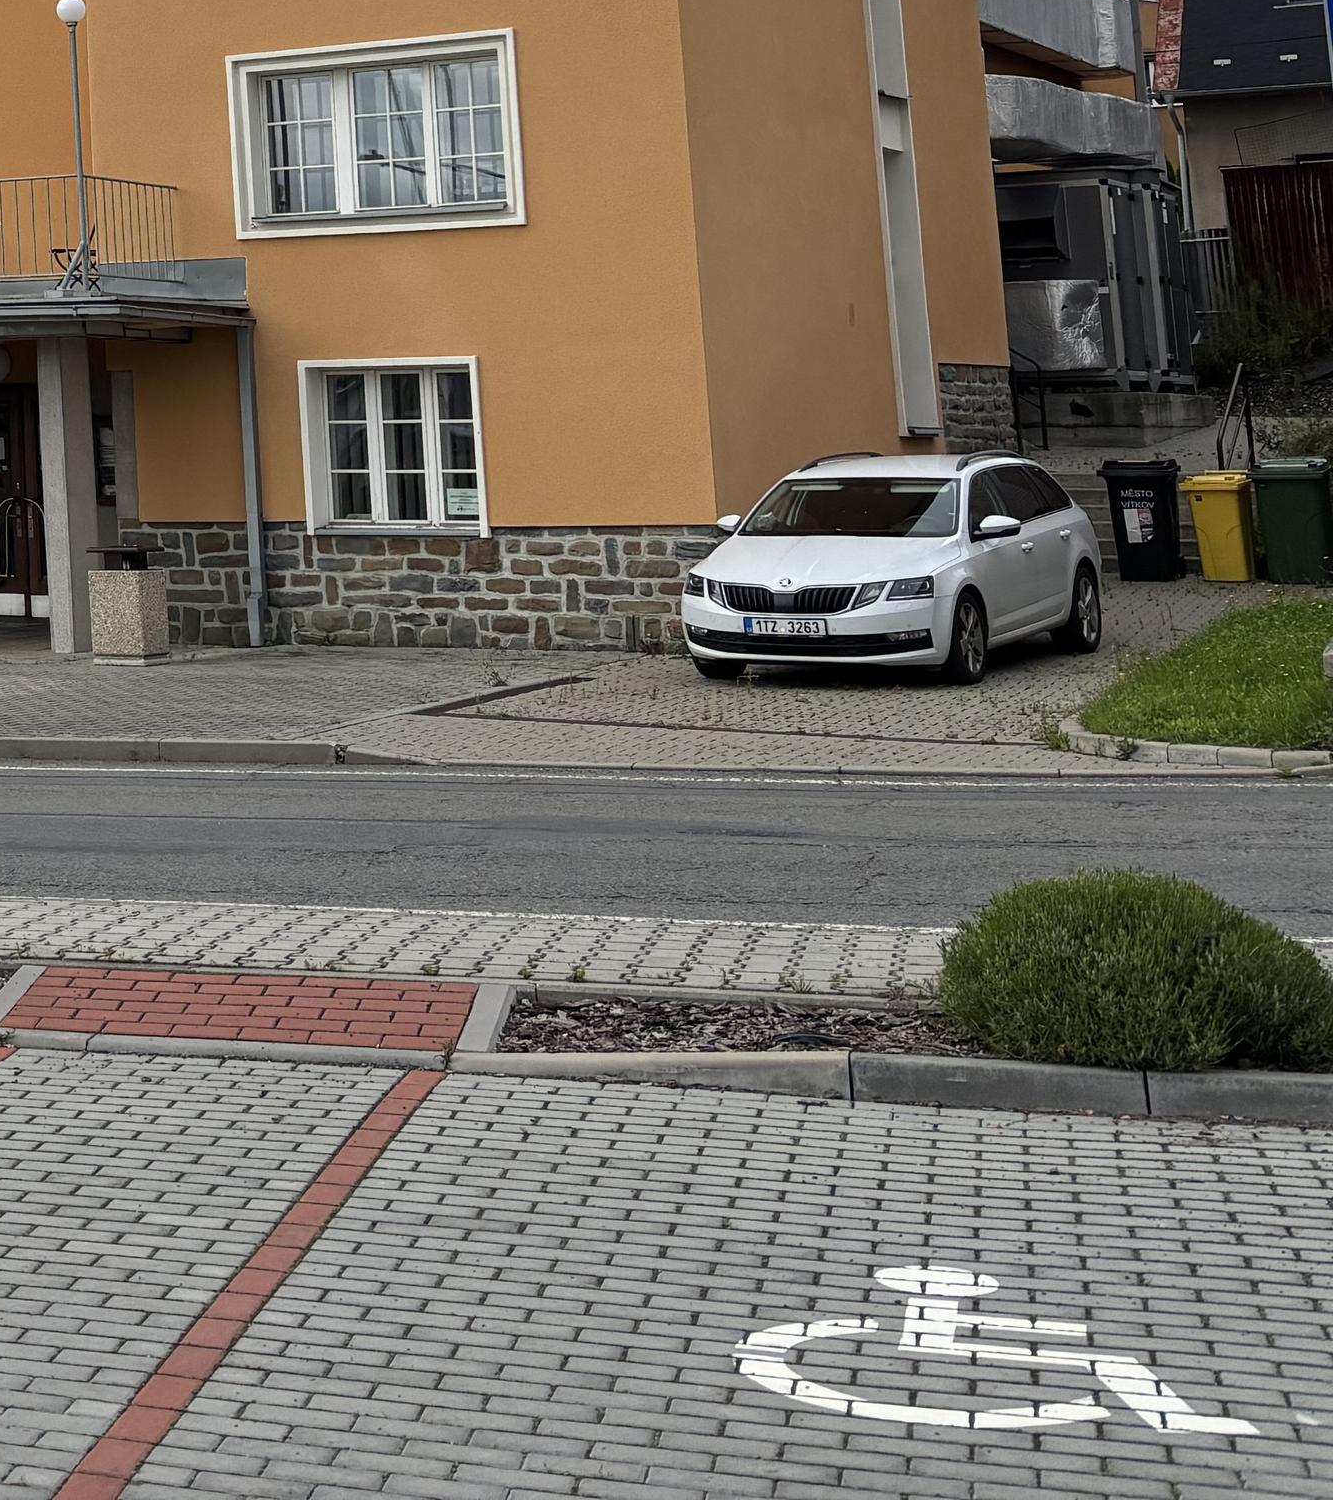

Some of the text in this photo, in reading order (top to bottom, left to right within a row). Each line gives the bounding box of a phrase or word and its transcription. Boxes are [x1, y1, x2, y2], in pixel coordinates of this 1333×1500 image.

[1120, 488, 1154, 498] MĚSTO
[1121, 500, 1155, 509] VÍTKOV
[755, 620, 820, 634] 1TZ 3263
